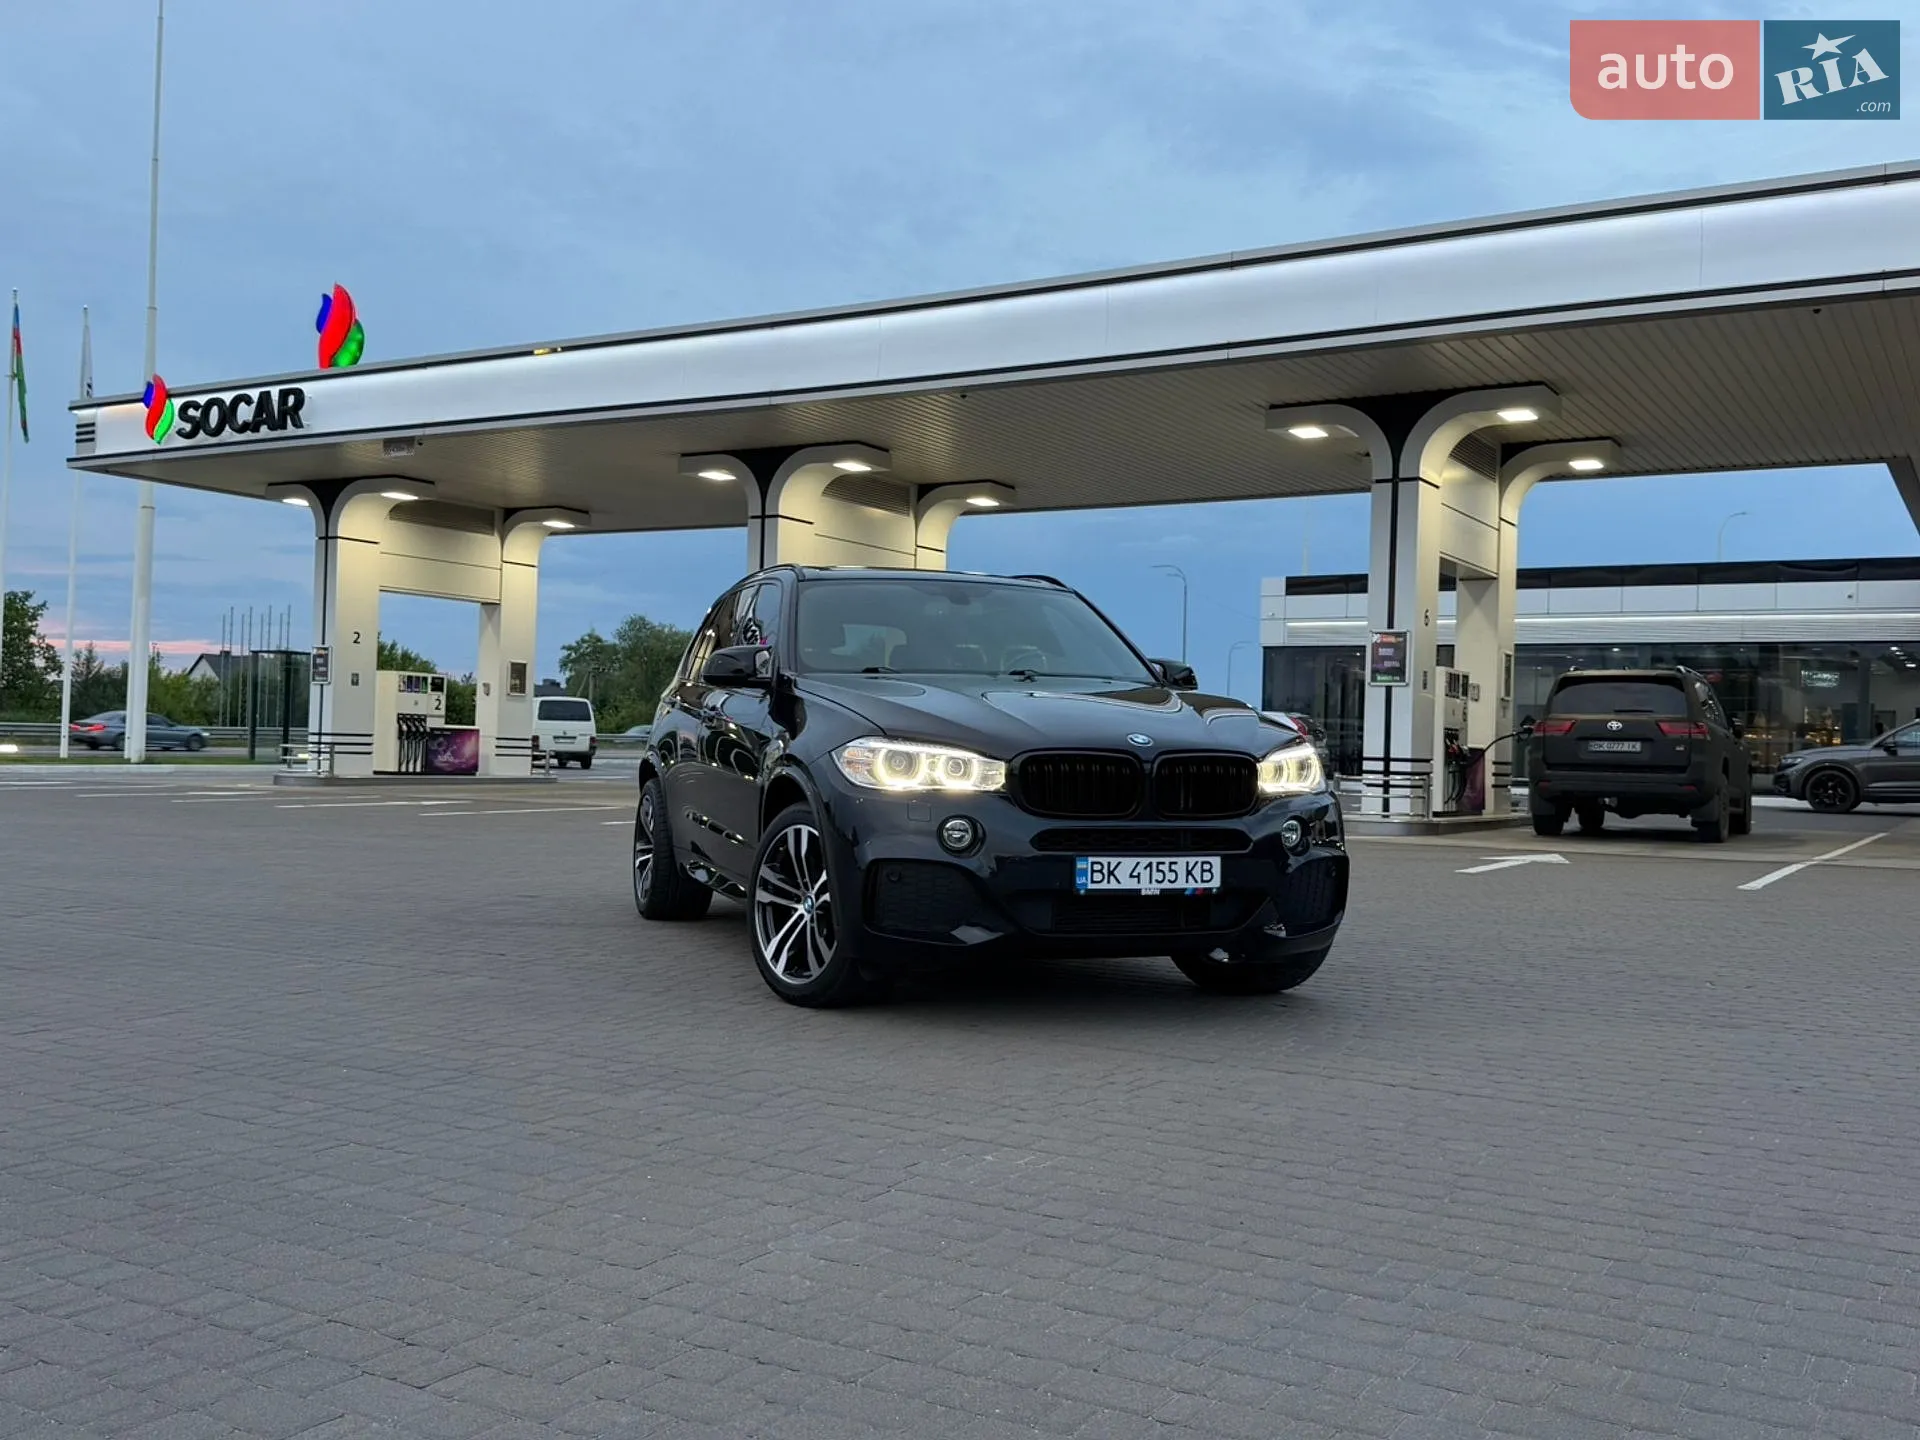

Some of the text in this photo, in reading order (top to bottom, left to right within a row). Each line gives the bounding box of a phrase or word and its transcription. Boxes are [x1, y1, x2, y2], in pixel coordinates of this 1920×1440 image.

[176, 387, 305, 440] SOCAR
[1423, 608, 1430, 627] 6
[352, 631, 361, 644] 2
[434, 698, 442, 711] 2
[1090, 860, 1215, 885] BK 4155 KB
